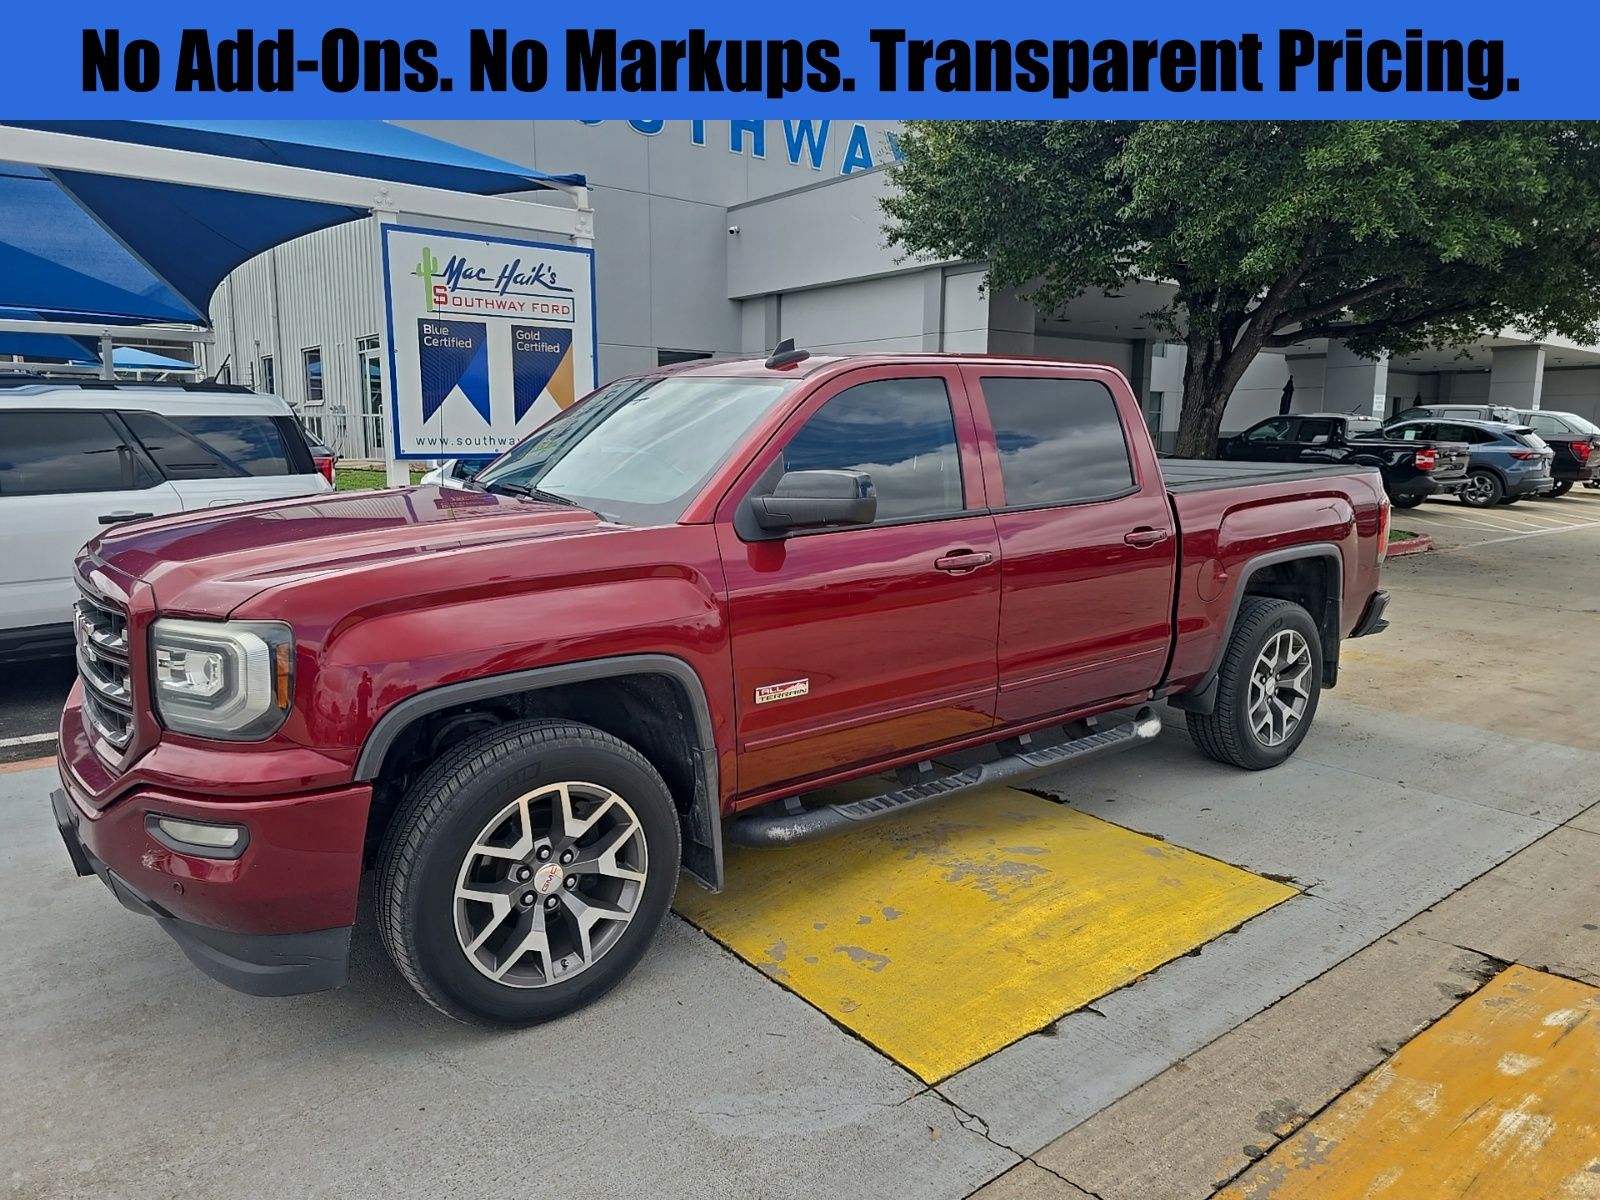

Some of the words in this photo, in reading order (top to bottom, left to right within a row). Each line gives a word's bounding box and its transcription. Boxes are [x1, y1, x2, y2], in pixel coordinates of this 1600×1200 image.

[438, 255, 494, 292] Mac
[495, 258, 572, 296] Haik's
[433, 285, 525, 312] SOUTHWAY
[531, 303, 570, 315] FORD
[423, 324, 449, 336] Blue
[515, 330, 540, 341] Gold
[423, 336, 472, 349] Certified
[516, 341, 560, 353] Certified
[415, 435, 522, 446] www.southwa
[760, 687, 807, 702] TERRAIN
[761, 686, 784, 696] ALL
[541, 865, 558, 892] GMC
